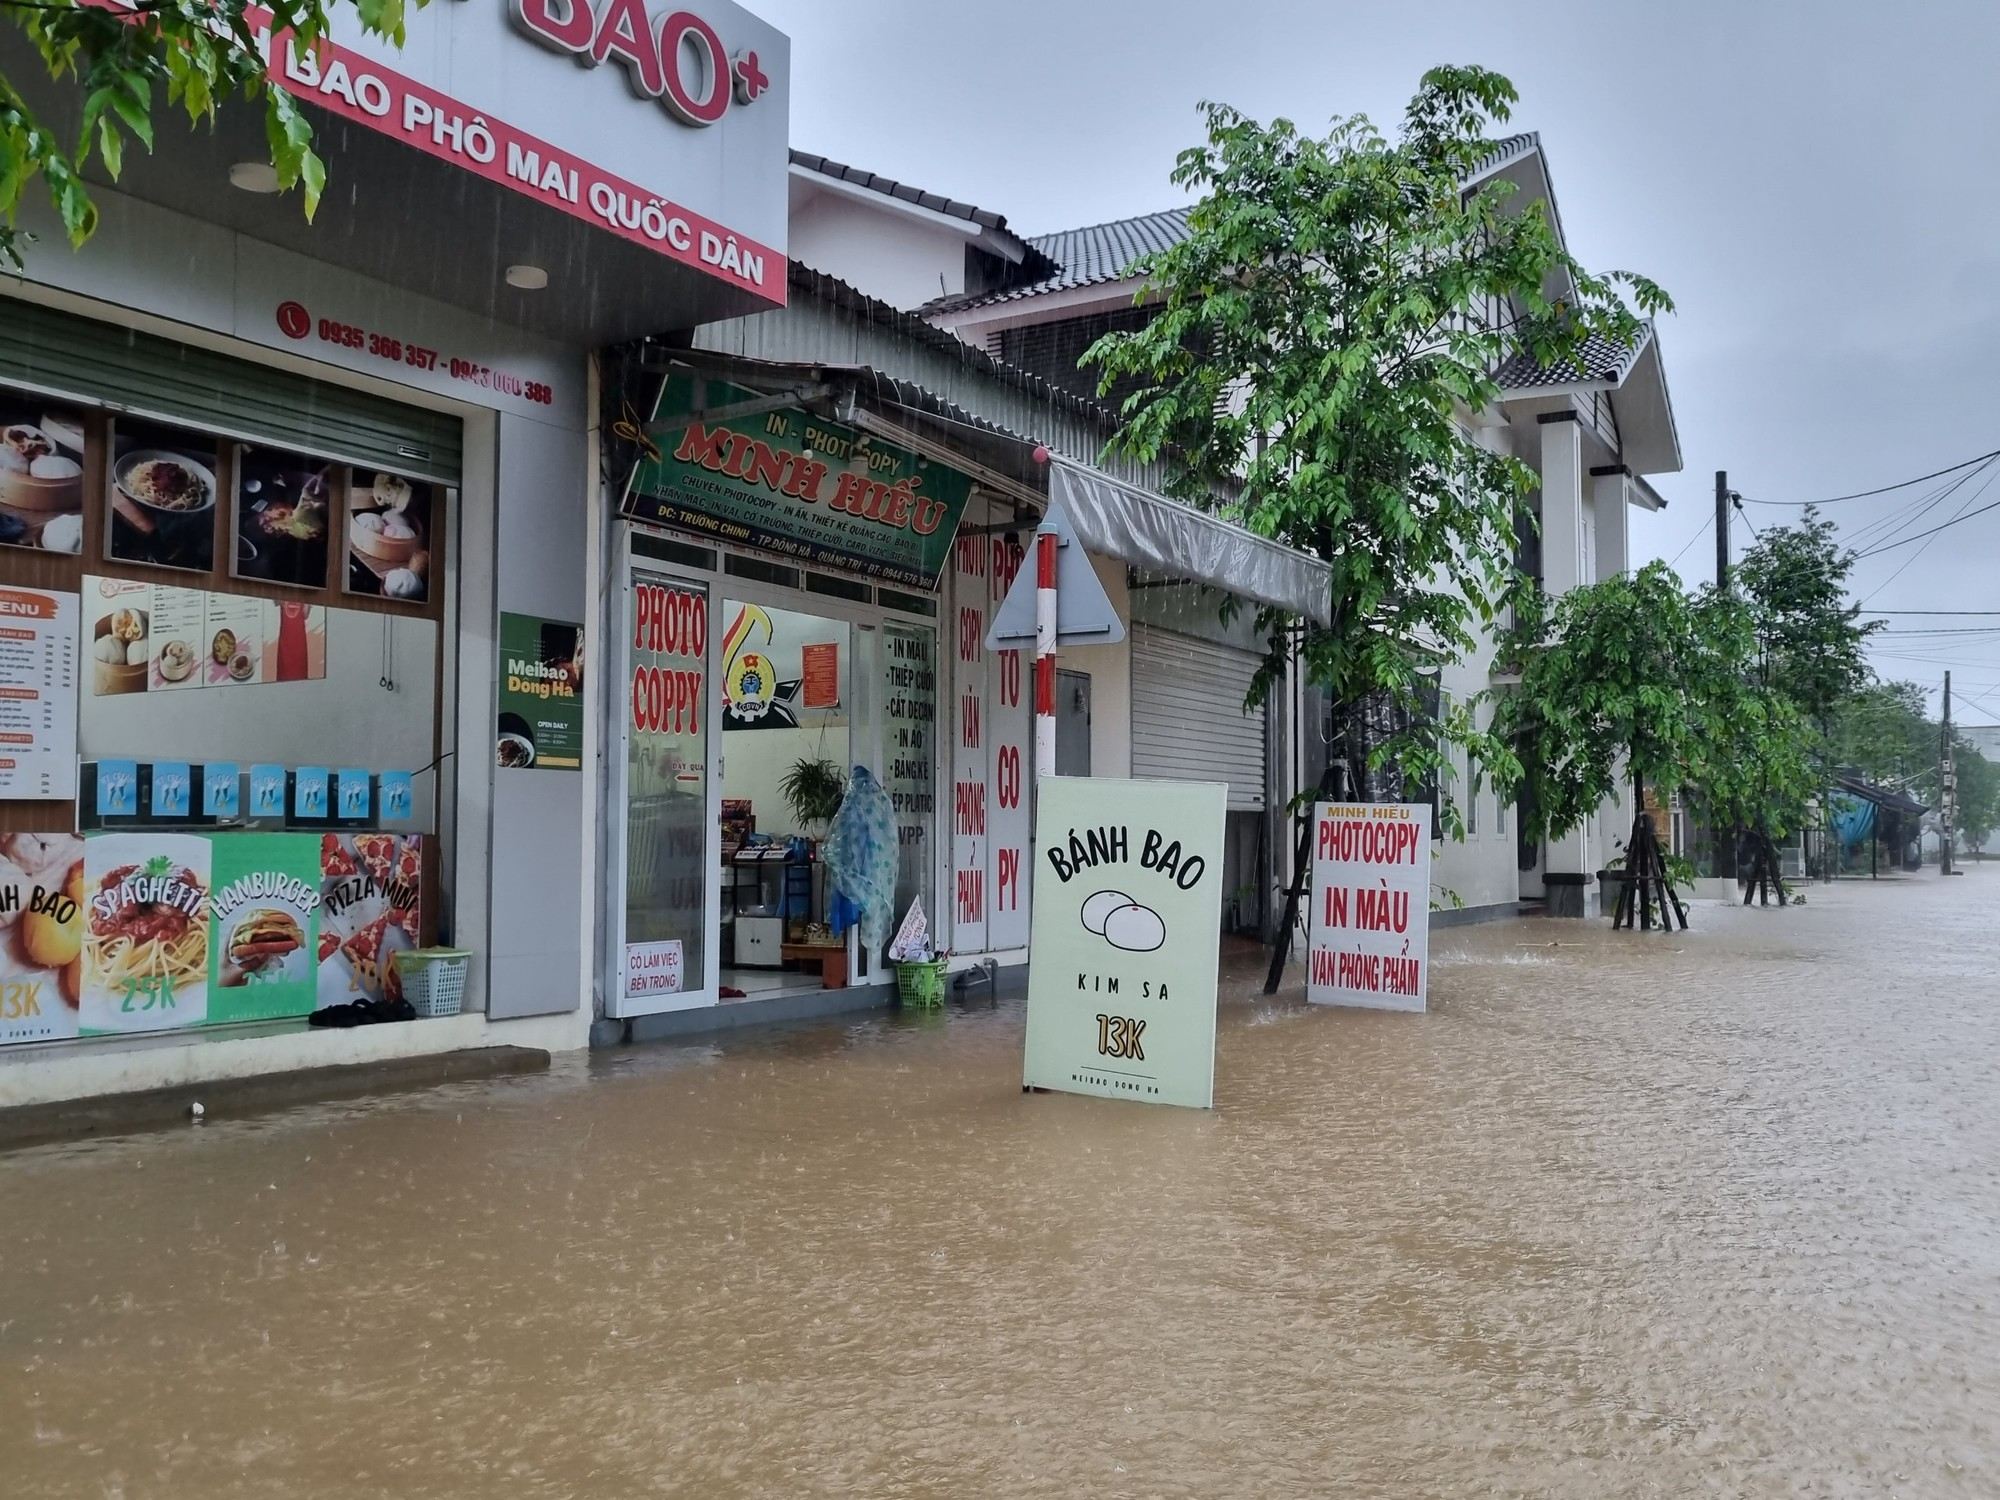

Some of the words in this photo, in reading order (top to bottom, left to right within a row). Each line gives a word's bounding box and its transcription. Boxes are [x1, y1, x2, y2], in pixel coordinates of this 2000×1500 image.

[402, 93, 496, 164] PHÔ
[507, 141, 579, 203] MAI
[590, 182, 691, 252] QUỐC
[700, 229, 764, 286] DÂN
[318, 319, 364, 350] 0935
[369, 333, 402, 361] 366
[405, 343, 438, 371] 357
[765, 412, 788, 438] IN
[674, 424, 827, 501] MINH
[830, 476, 947, 535] HIẾU
[658, 505, 677, 519] ĐC:
[720, 522, 750, 539] CHINH
[723, 488, 777, 511] PHOTOCOPY
[783, 506, 794, 516] IN
[635, 583, 706, 659] PHOTO
[960, 606, 982, 663] COPY
[508, 658, 568, 681] Meibao
[894, 637, 904, 658] IN
[508, 676, 550, 699] Đông
[633, 664, 702, 737] COPPY
[998, 649, 1020, 708] TO
[899, 728, 908, 748] IN
[961, 684, 980, 749] VĂN
[998, 745, 1020, 809] CO
[905, 793, 932, 814] PLATIC
[956, 767, 985, 837] PHÒNG
[1327, 806, 1367, 818] MINH
[1372, 803, 1410, 820] HIẾU
[1047, 826, 1129, 883] BÁNH
[1140, 829, 1205, 890] BAO
[1318, 820, 1420, 865] PHOTOCOPY
[92, 876, 210, 920] SPAGHETTI
[210, 871, 320, 921] HAMBURGER
[324, 876, 375, 916] PIZZA
[998, 848, 1020, 911] PY
[30, 885, 76, 924] BAO
[1325, 886, 1348, 929] IN
[1355, 878, 1409, 934] MÀU
[630, 954, 642, 970] CÓ
[643, 952, 660, 969] LÀM
[661, 951, 679, 971] VIỆC
[630, 973, 648, 991] BÊN
[649, 974, 676, 989] TRONG
[1312, 943, 1336, 987] VĂN
[1339, 943, 1379, 992] PHÒNG
[1382, 938, 1419, 997] PHẨM
[121, 977, 177, 1013] 25K
[1078, 973, 1119, 994] KIM
[1142, 981, 1168, 1000] SA
[1096, 1013, 1147, 1061] 13K
[1072, 1074, 1107, 1086] MEIBAO
